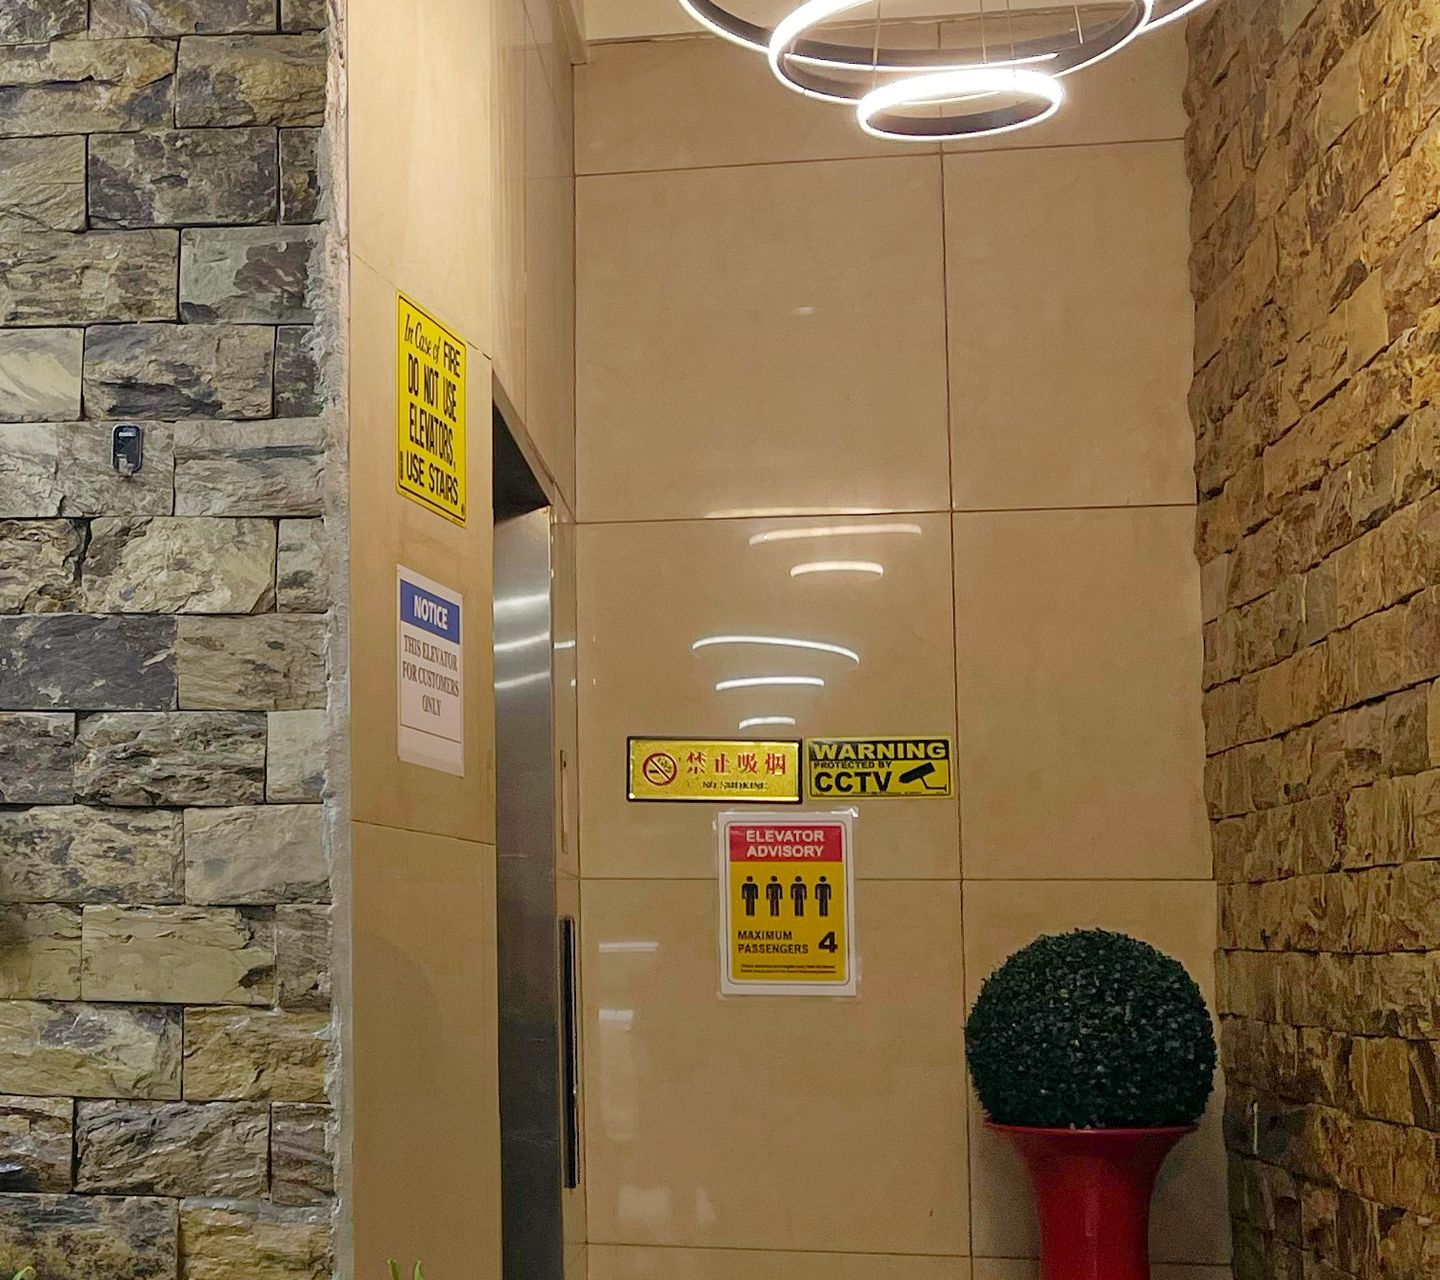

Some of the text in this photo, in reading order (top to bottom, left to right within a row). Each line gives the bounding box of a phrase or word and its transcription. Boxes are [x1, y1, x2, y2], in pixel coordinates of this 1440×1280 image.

[404, 313, 461, 379] In Case of FIRE
[408, 352, 457, 423] DO NOT USE
[409, 401, 457, 474] ELEVATORS,
[406, 449, 425, 489] USE
[428, 462, 459, 507] STAIRS
[413, 594, 449, 630] NOTICE
[403, 635, 458, 672] THIS ELEVATOR
[402, 661, 460, 697] FOR CUSTOMERS
[422, 694, 442, 716] ONLY
[813, 742, 946, 760] WARNING
[686, 751, 786, 775] 禁止吸烟
[813, 760, 893, 769] PROTECTED BY
[814, 771, 893, 793] CCTV
[745, 830, 825, 843] ELEVATOR
[746, 845, 825, 858] ADVISORY
[737, 930, 793, 941] MAXIMUM
[817, 931, 838, 954] 4
[737, 943, 809, 955] PASSENGERS
